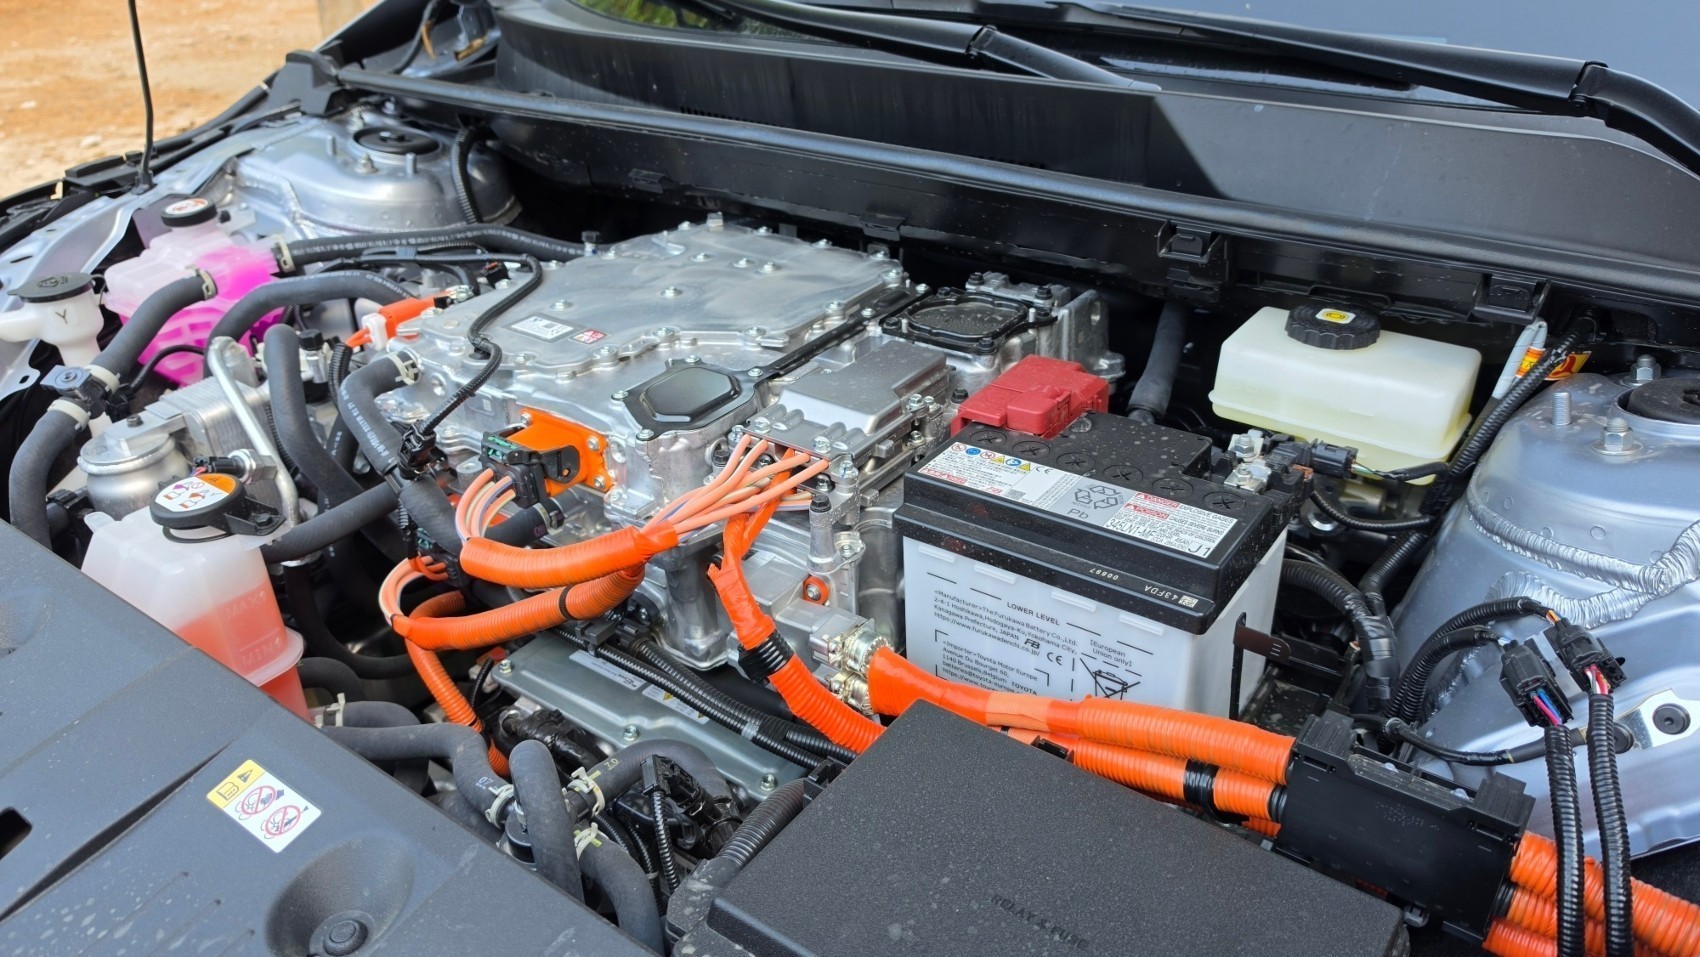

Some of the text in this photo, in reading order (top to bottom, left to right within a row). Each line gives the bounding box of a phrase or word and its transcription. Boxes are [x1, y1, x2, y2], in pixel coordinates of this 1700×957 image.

[1067, 508, 1089, 519] Pb
[1144, 584, 1179, 601] 43FDA
[934, 596, 950, 607] 2-4-1
[1007, 602, 1060, 626] LOWER LEVEL
[999, 629, 1019, 640] JAPAN
[1025, 622, 1051, 637] Battery
[942, 654, 957, 664] 1140
[942, 647, 964, 660] Avenue
[964, 656, 974, 664] Du
[975, 659, 998, 674] Bourget
[1092, 648, 1113, 660] Union
[997, 661, 1016, 672] Motor
[1016, 668, 1038, 682] Europe
[1011, 681, 1038, 696] TOYOTA
